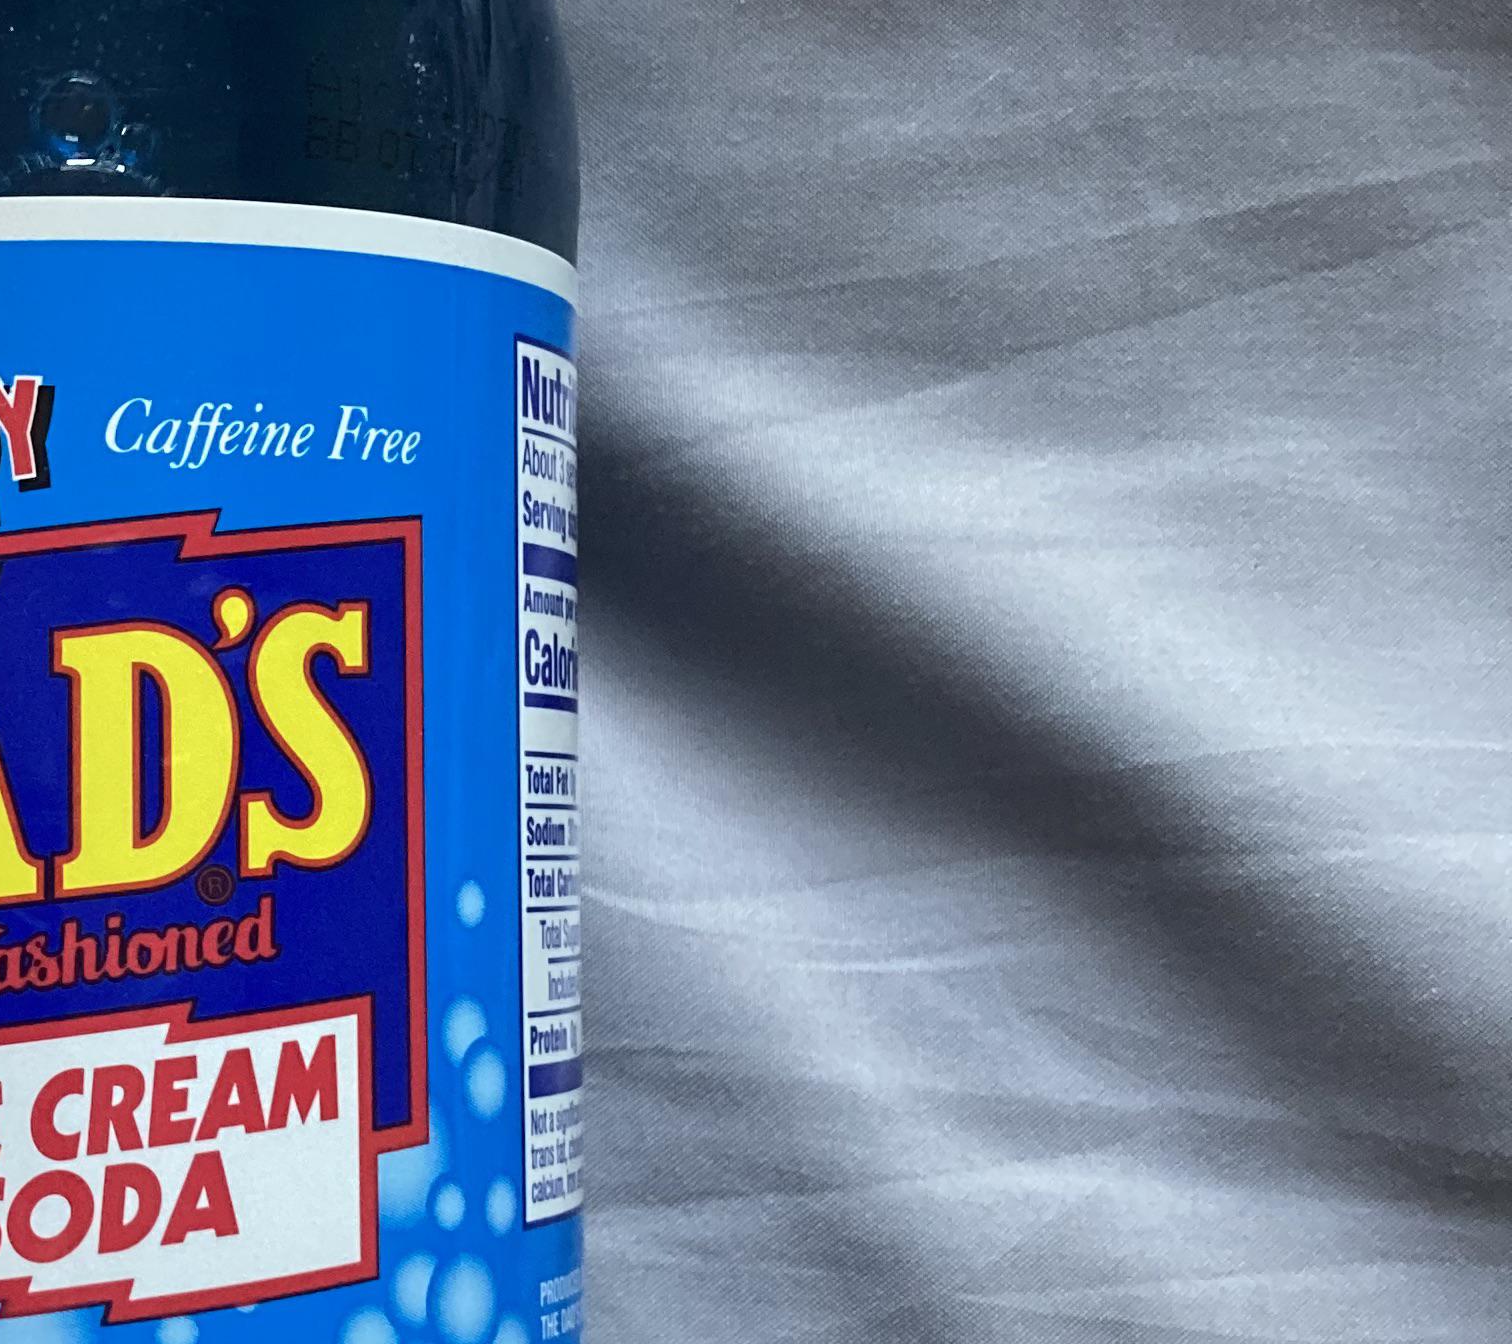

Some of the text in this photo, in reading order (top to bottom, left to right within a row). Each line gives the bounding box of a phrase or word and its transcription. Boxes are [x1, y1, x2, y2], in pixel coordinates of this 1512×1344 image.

[521, 355, 576, 435] Nutri
[104, 397, 421, 469] Caffeine Free
[526, 764, 554, 795] Total
[527, 868, 555, 898] Total
[30, 1033, 340, 1160] CREAM
